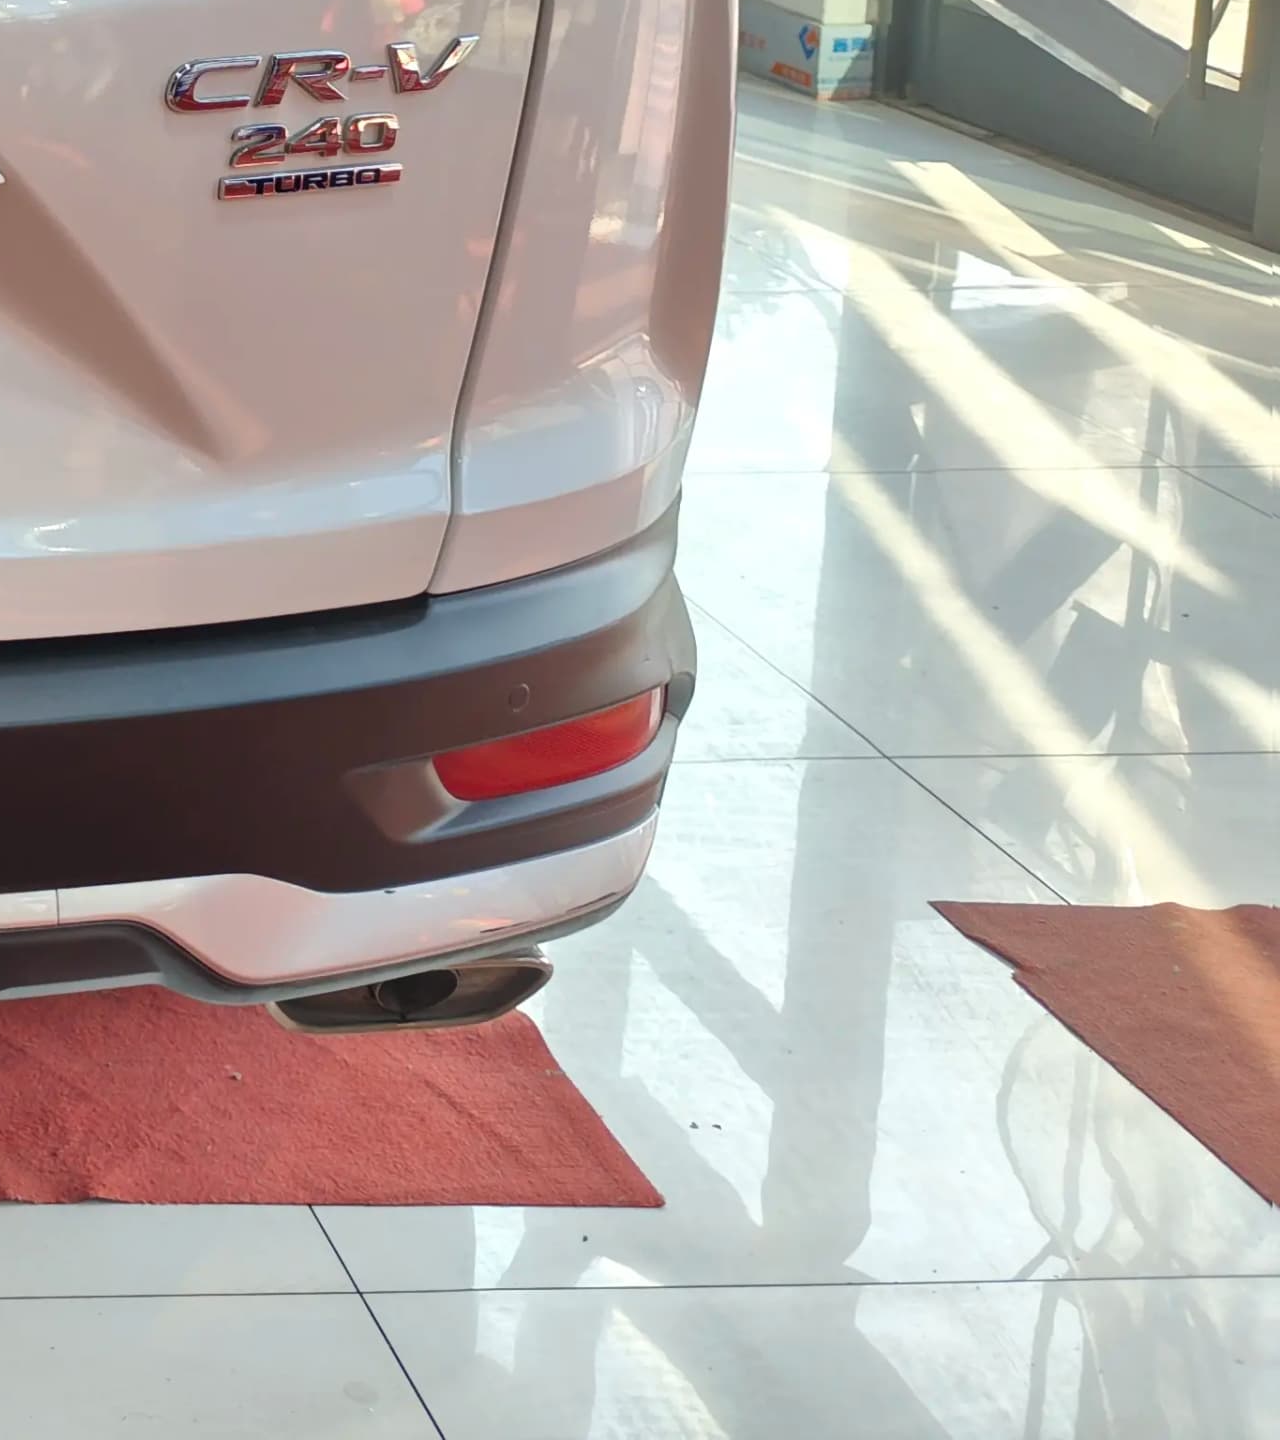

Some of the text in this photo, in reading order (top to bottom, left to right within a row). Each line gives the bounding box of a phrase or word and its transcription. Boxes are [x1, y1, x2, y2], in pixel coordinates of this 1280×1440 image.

[163, 33, 481, 113] CR-V
[229, 112, 400, 168] 240
[246, 167, 382, 196] TURBO
